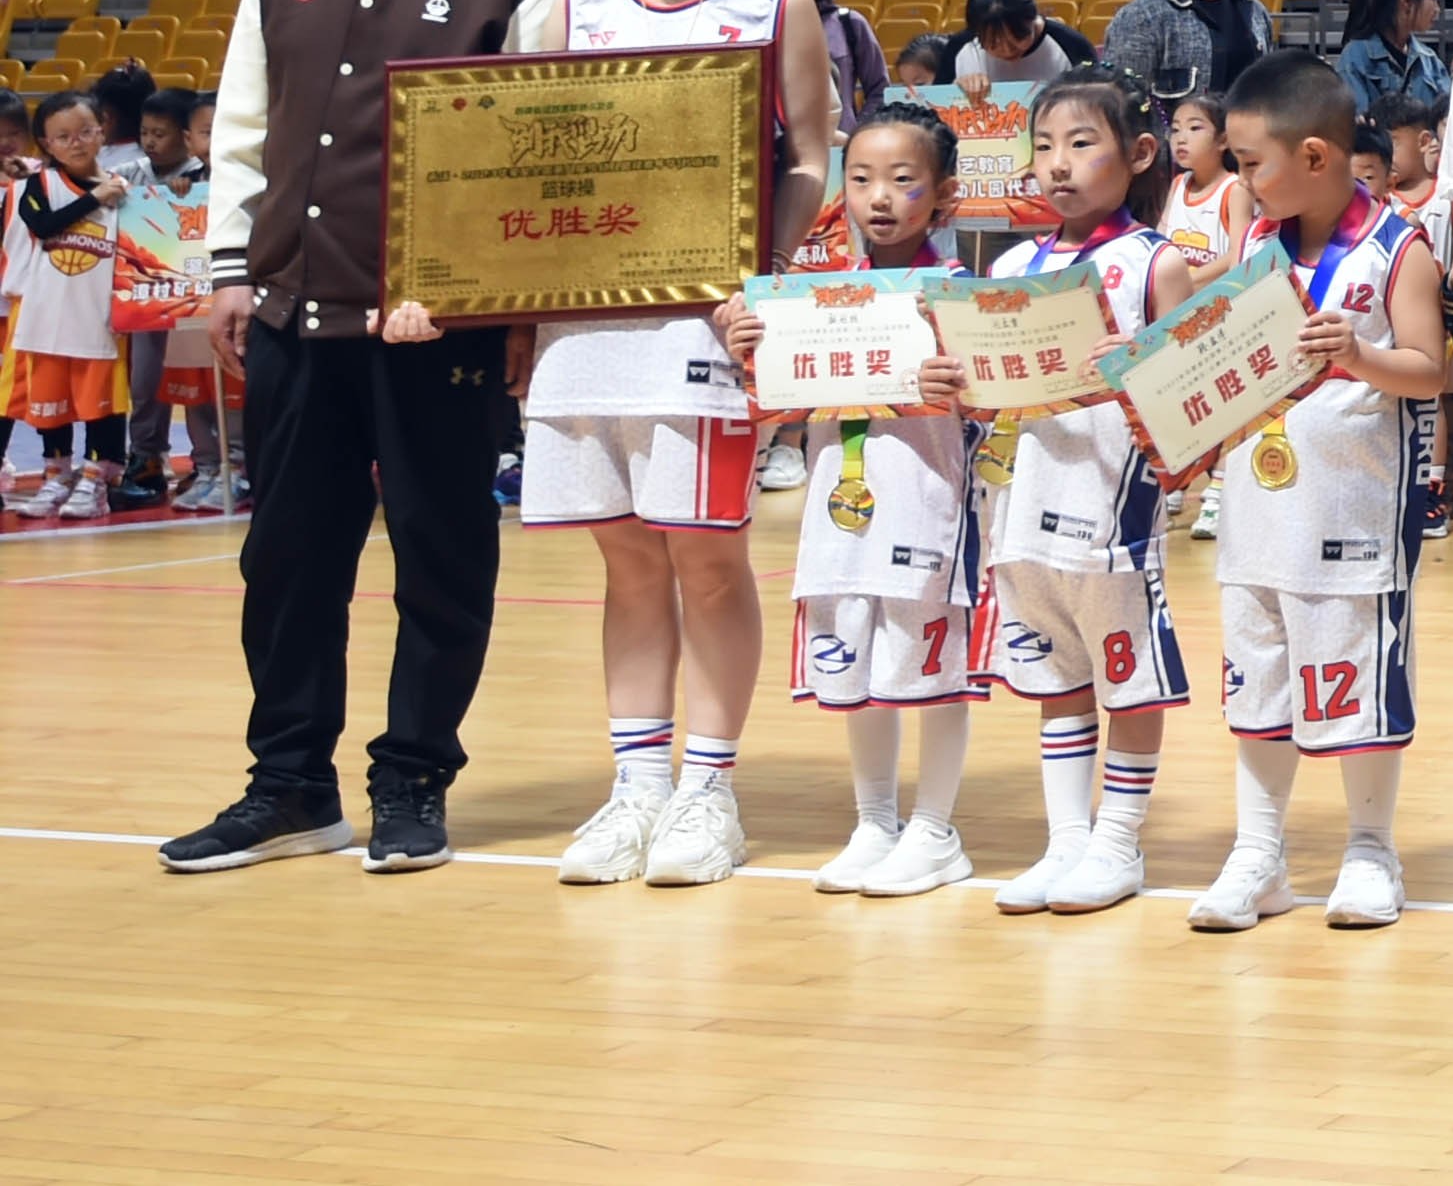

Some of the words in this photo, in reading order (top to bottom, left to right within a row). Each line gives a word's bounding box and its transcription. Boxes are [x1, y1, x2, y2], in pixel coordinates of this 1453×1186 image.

[540, 179, 596, 200] 篮球操
[498, 203, 641, 242] 优胜奖
[1103, 264, 1125, 291] 8
[1340, 282, 1374, 314] 12
[793, 350, 892, 380] 优胜奖
[971, 347, 1069, 382] 优胜奖
[1181, 343, 1279, 427] 优胜奖
[921, 617, 949, 676] 7
[1103, 630, 1137, 684] 8
[1299, 661, 1360, 722] 12
